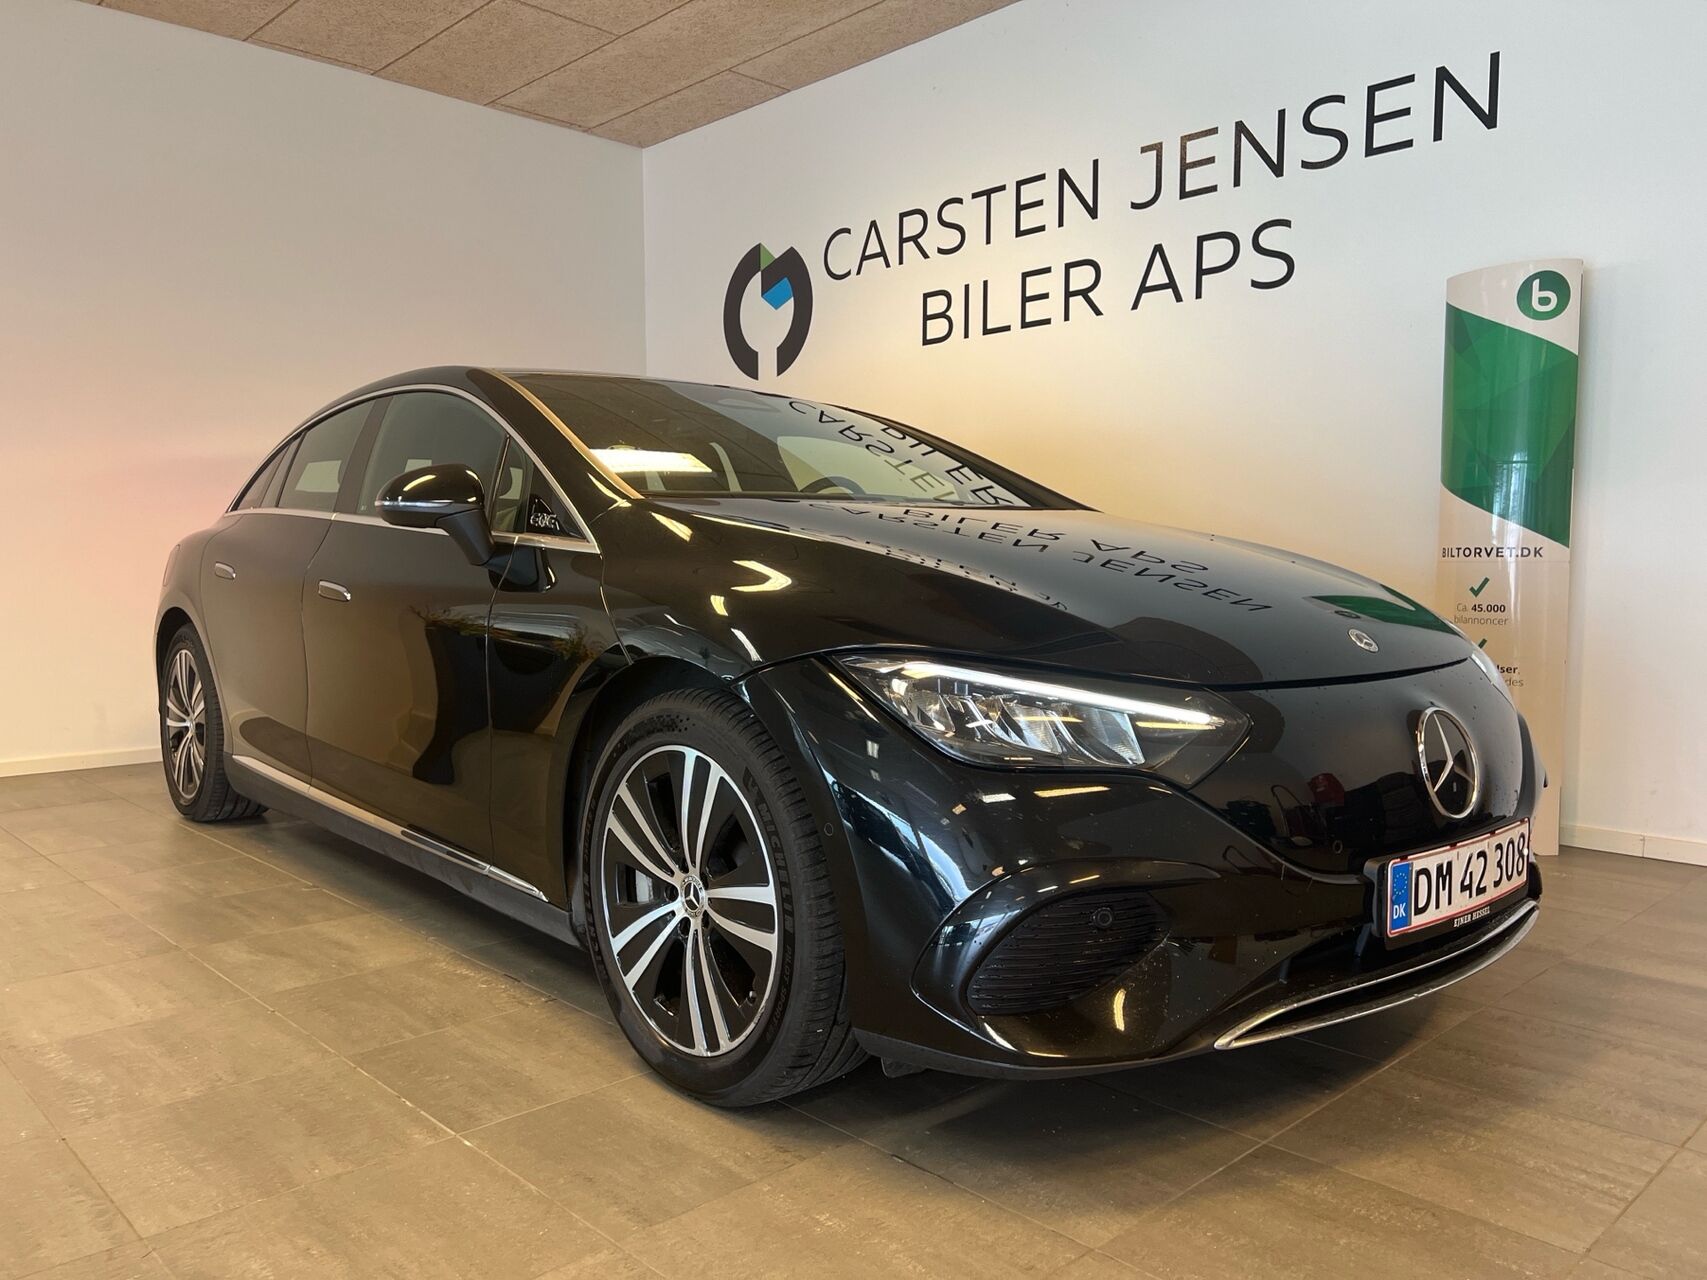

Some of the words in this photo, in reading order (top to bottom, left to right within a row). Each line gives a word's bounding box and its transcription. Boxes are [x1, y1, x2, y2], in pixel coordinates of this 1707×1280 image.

[823, 158, 1099, 281] CARSTEN
[1130, 51, 1500, 210] JENSEN
[922, 258, 1104, 346] BILER
[1130, 218, 1296, 311] APS
[1441, 546, 1544, 559] BILTORVET.DK
[1471, 603, 1506, 613] 45.000
[1453, 615, 1509, 626] bilannoncer
[757, 802, 795, 935] MICHELIN
[1413, 860, 1453, 917] DM
[1459, 850, 1488, 900] 42
[1493, 831, 1526, 889] 308
[1393, 902, 1406, 920] DK
[1472, 905, 1490, 921] HESSEL
